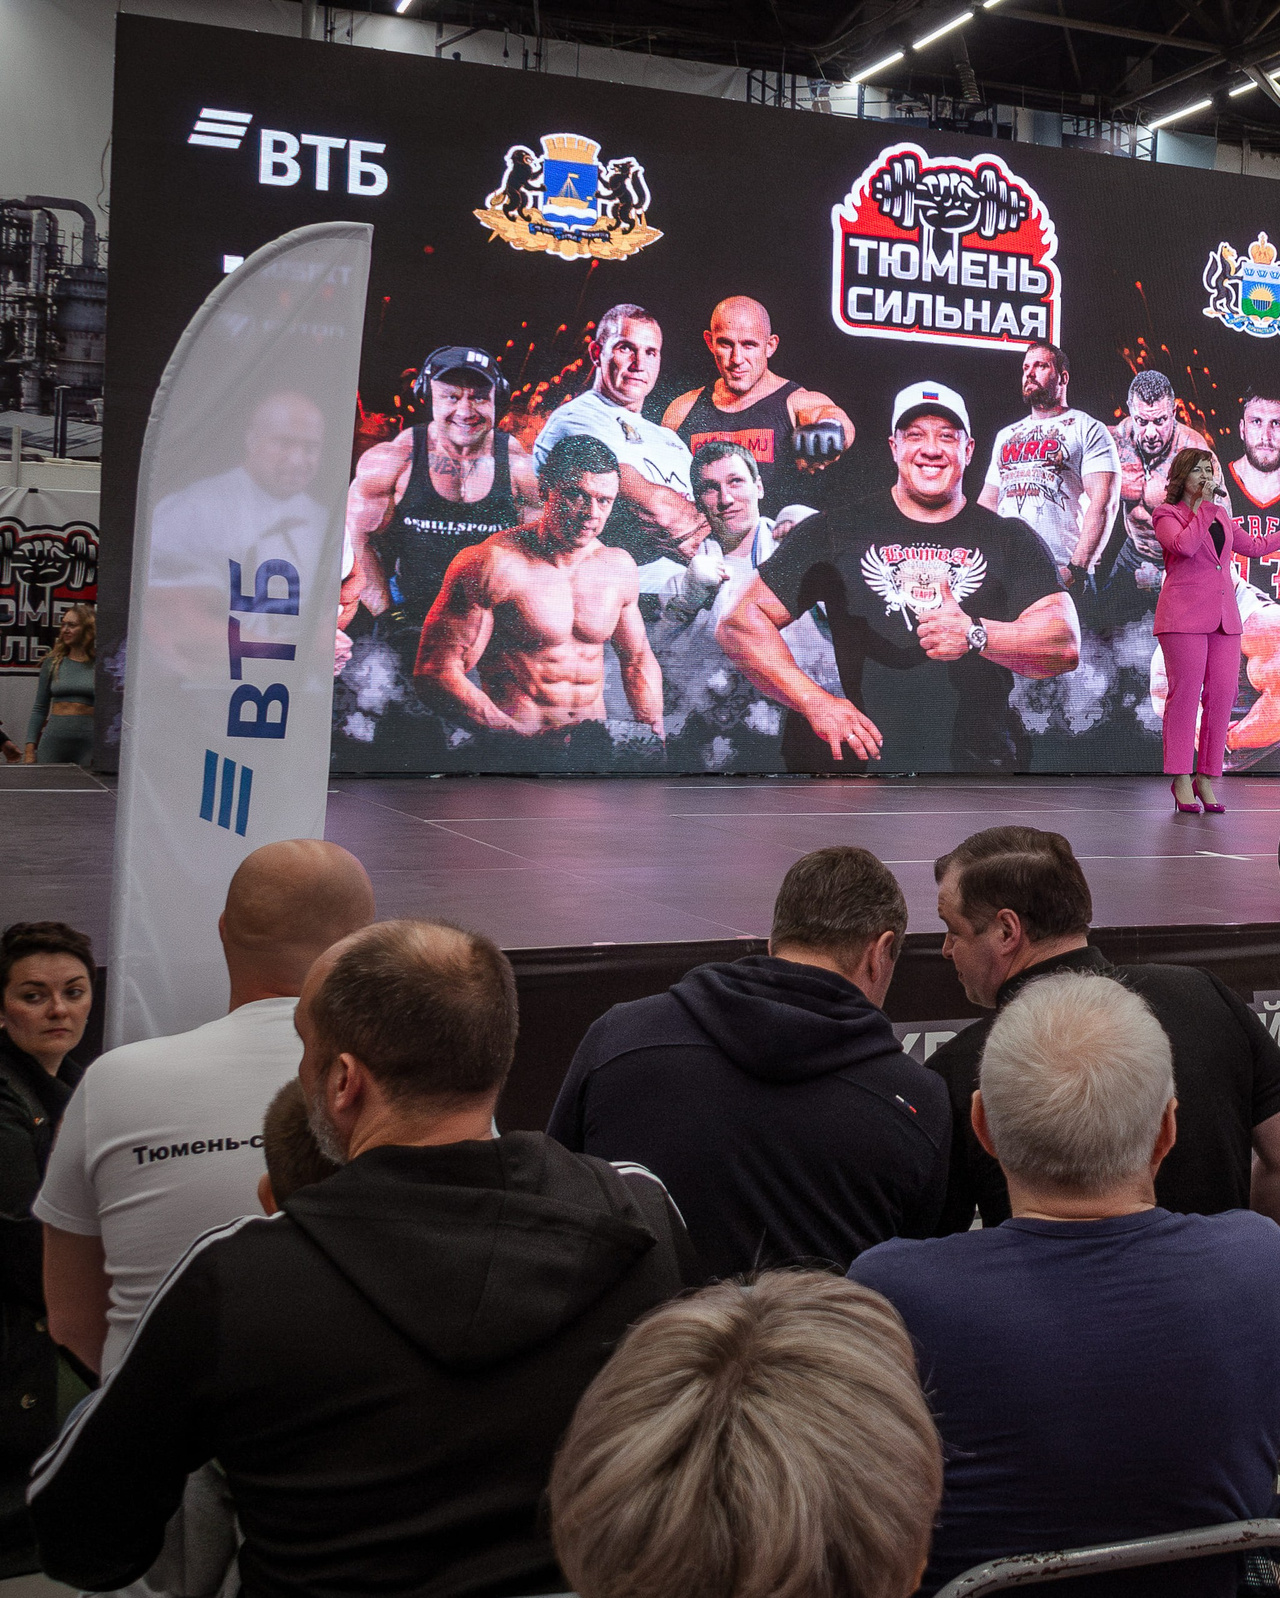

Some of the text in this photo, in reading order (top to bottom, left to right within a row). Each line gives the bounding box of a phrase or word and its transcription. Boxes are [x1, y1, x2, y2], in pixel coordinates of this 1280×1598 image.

[259, 128, 389, 197] ВТБ
[848, 237, 1049, 295] ТЮМЕНЬ
[847, 286, 1048, 338] СИЛЬНАЯ
[227, 558, 299, 739] ВТБ
[132, 1134, 265, 1165] Тюмень-с
